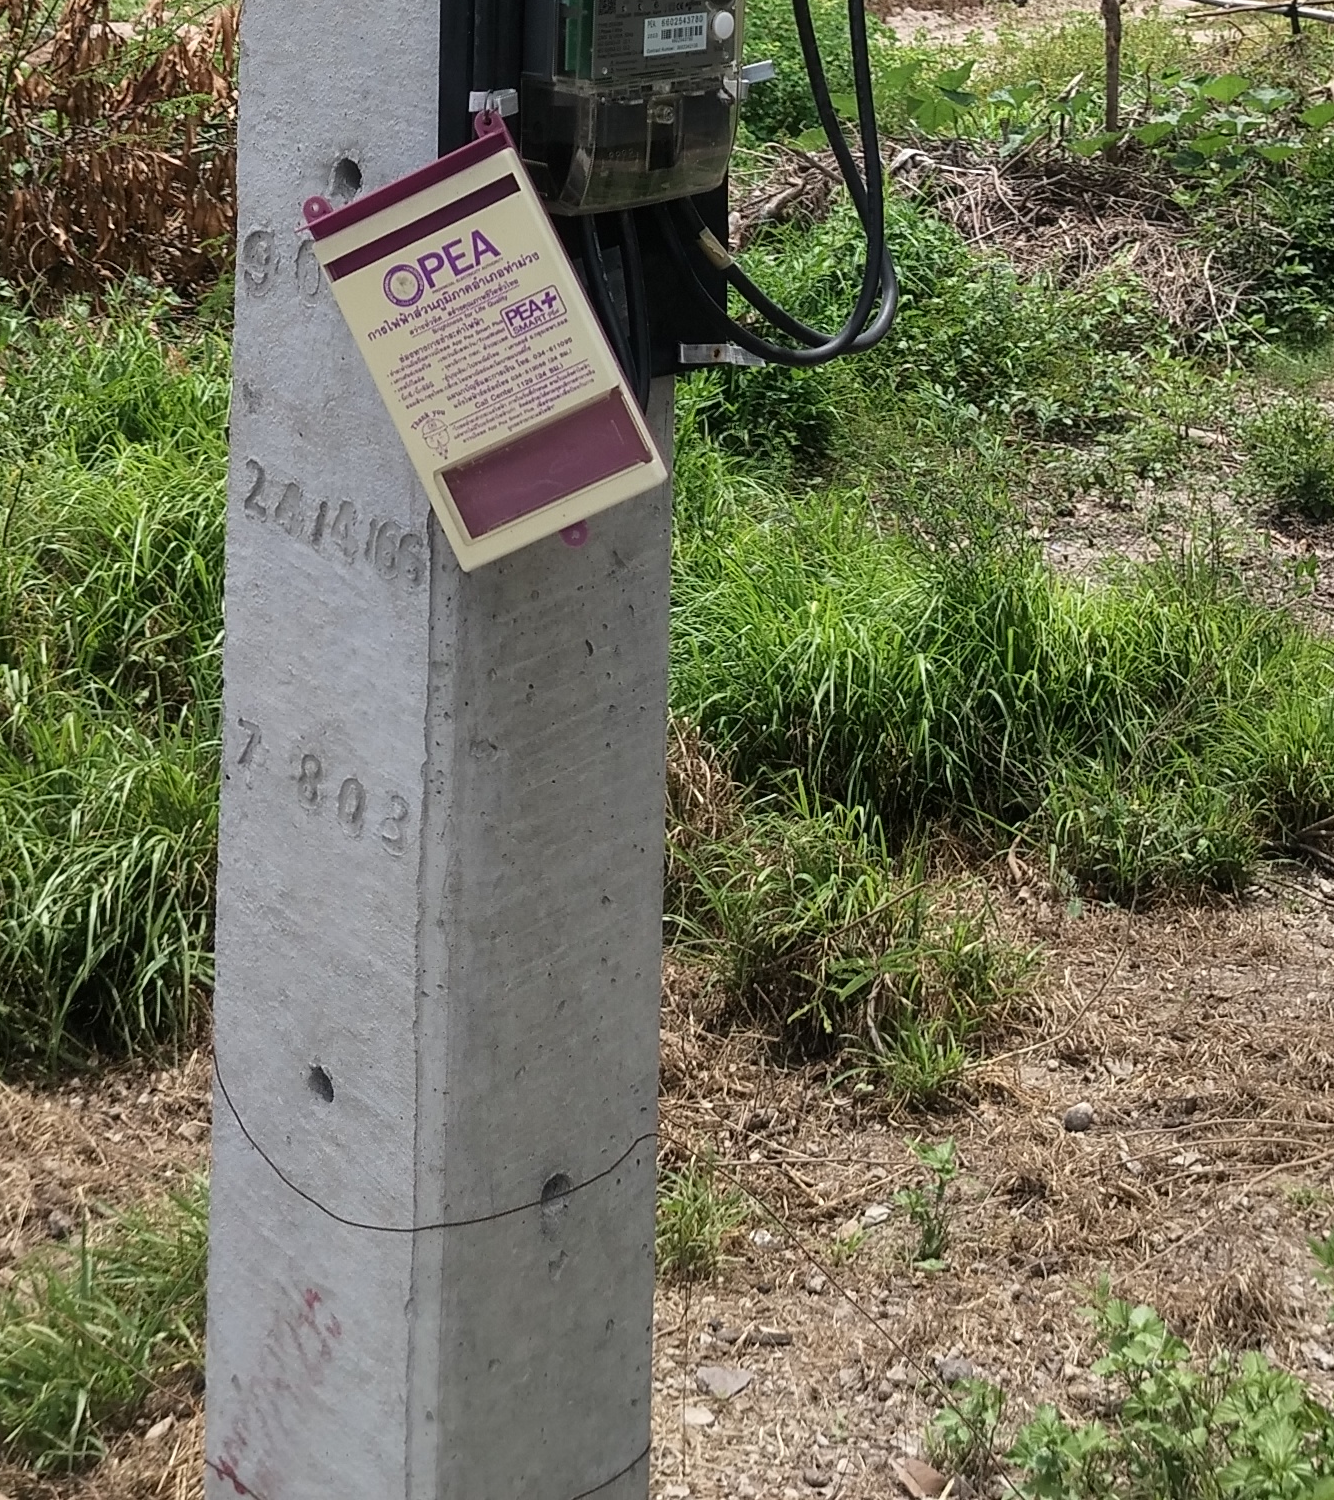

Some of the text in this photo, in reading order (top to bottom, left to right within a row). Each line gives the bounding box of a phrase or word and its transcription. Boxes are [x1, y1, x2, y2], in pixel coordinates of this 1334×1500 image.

[416, 229, 501, 289] PEA
[474, 398, 488, 408] Call
[490, 386, 513, 401] Center
[516, 377, 533, 388] 1129
[410, 409, 445, 430] Thank you
